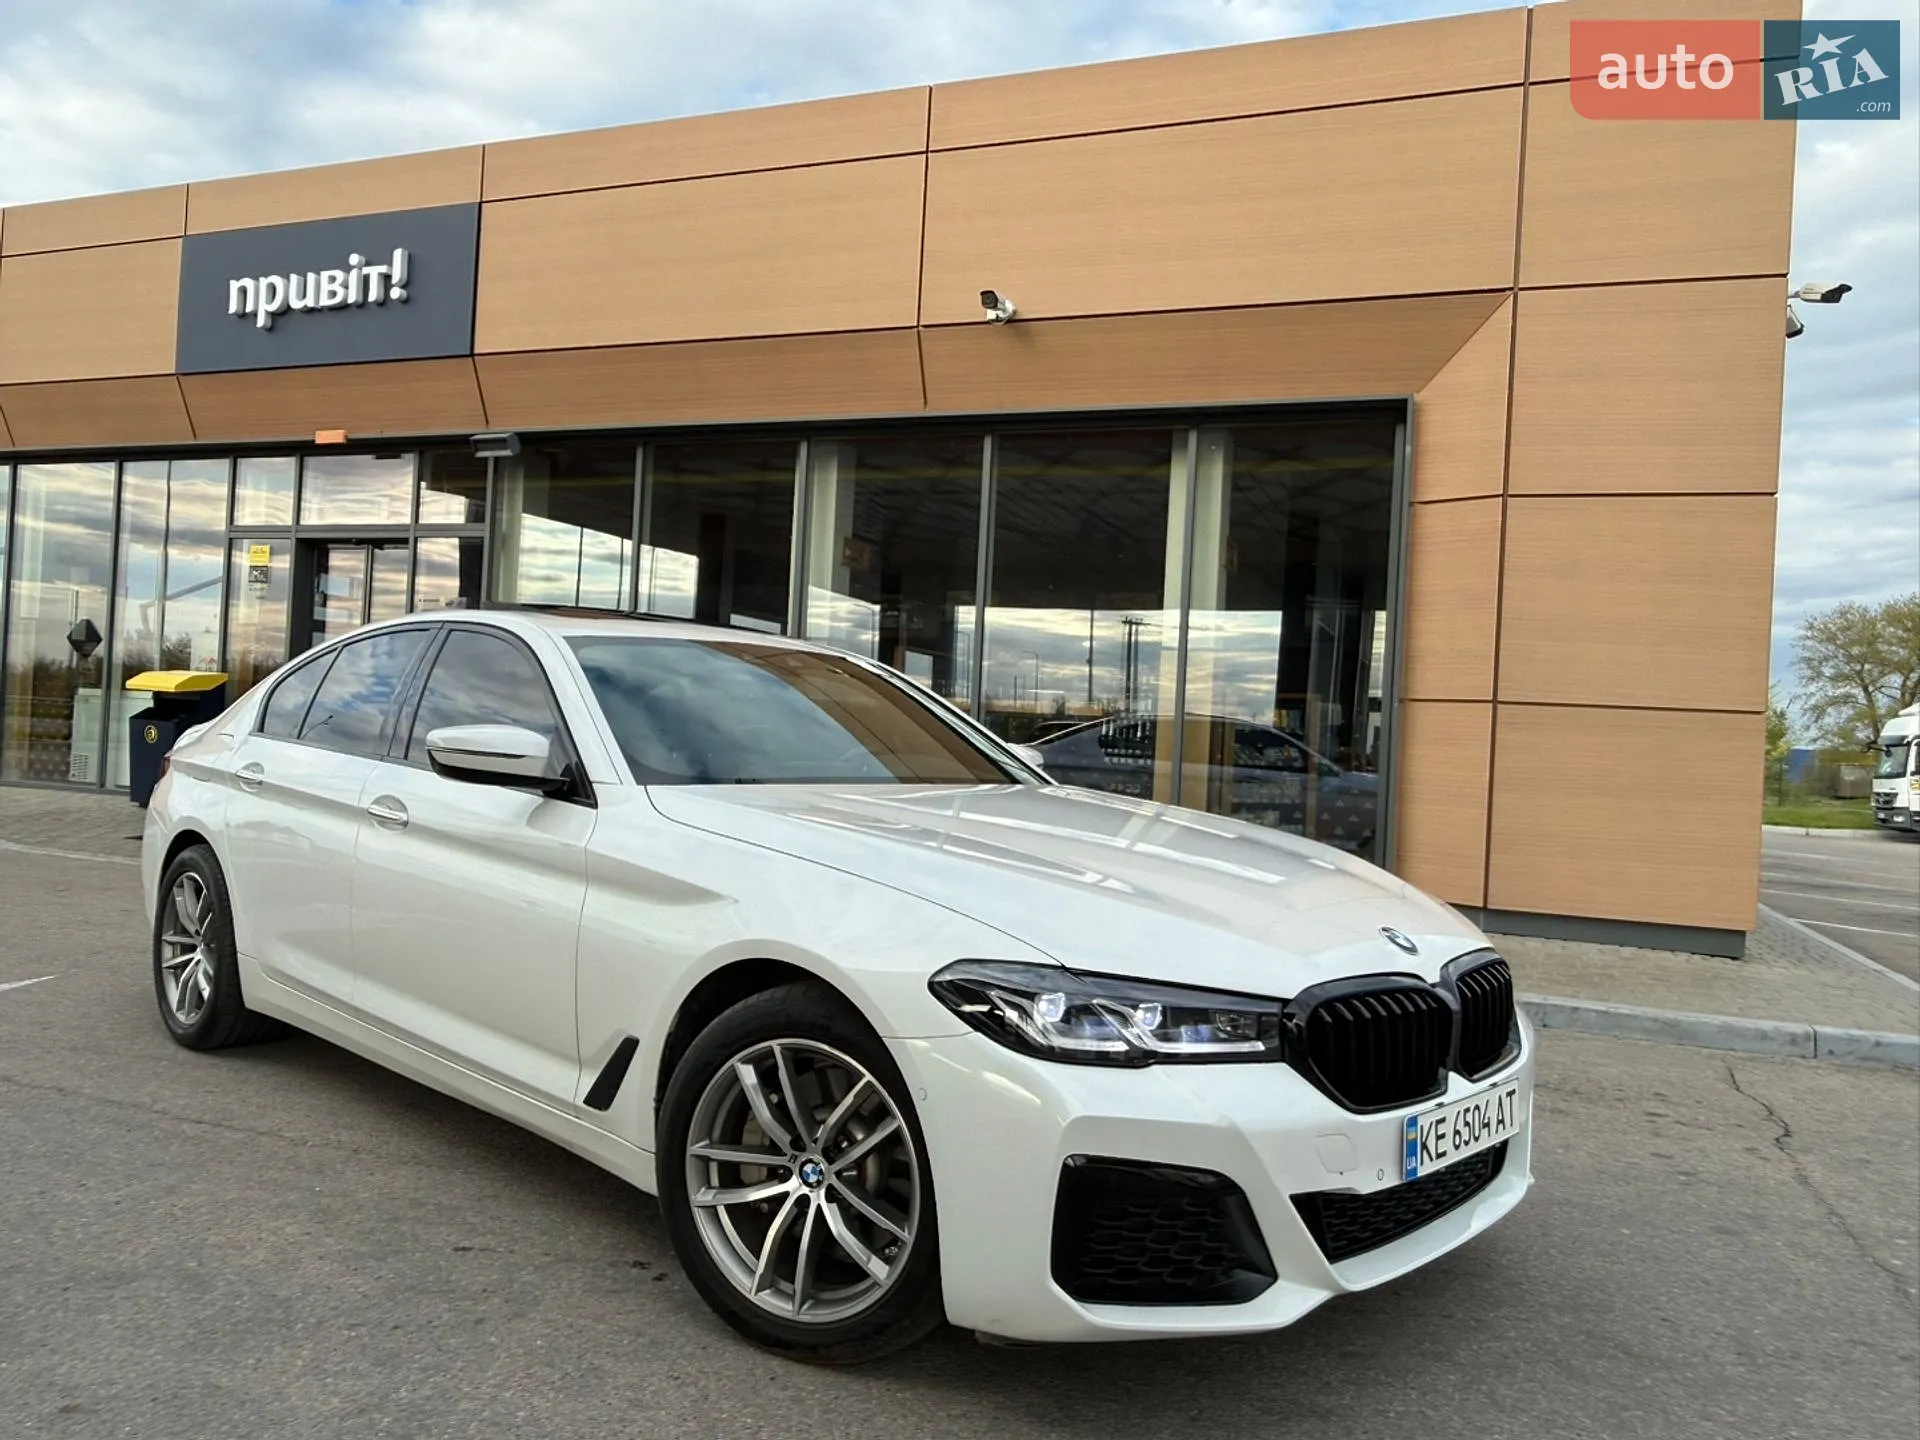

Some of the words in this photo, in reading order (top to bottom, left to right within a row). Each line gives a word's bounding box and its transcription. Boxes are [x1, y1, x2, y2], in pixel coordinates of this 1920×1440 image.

[228, 247, 409, 328] привіт!
[1420, 1116, 1447, 1166] KE
[1453, 1099, 1491, 1151] 6504
[1495, 1088, 1516, 1134] AT
